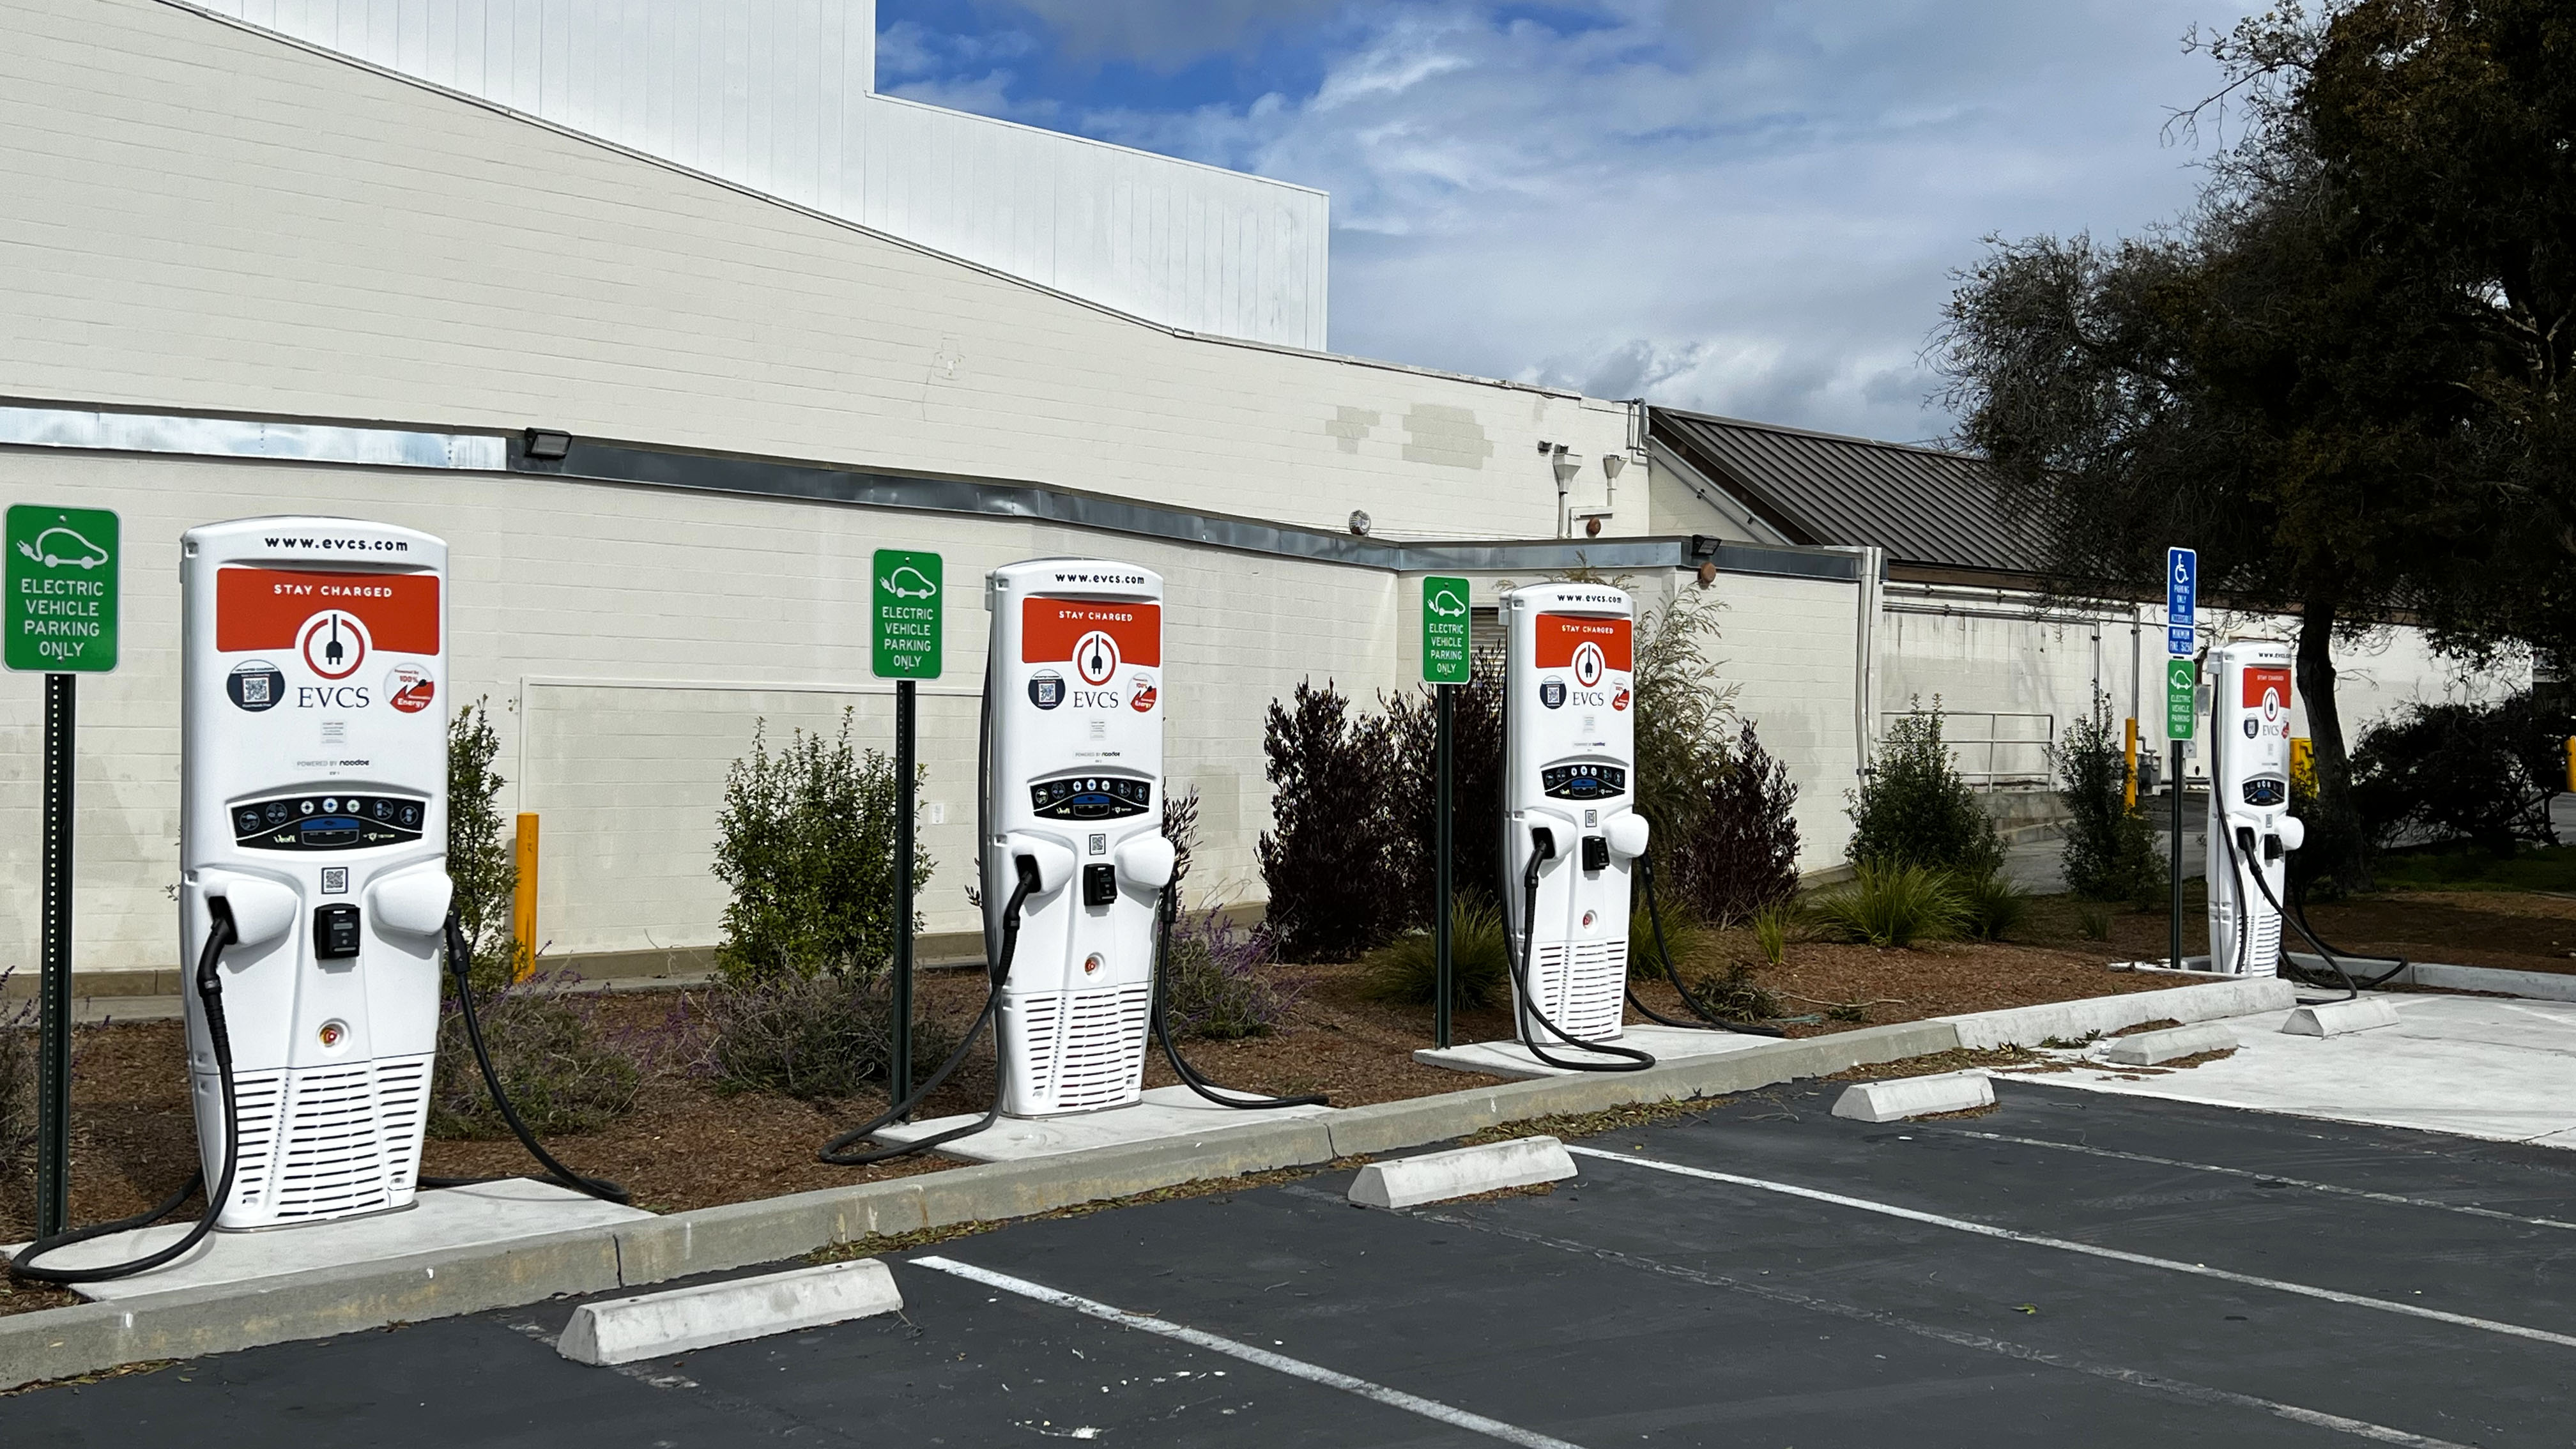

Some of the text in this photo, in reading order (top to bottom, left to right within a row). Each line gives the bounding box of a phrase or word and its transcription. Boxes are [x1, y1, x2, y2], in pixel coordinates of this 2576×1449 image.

[265, 536, 408, 551] www.evcs.com
[1055, 573, 1145, 585] www.evcs.com
[22, 579, 103, 596] ELECTRIC
[274, 585, 392, 597] STAY CHARGED
[2174, 585, 2189, 594] PARKING
[26, 599, 99, 617] VEHICLE
[882, 607, 933, 620] ELECTRIC
[1059, 611, 1133, 622] STAY CHARGED
[24, 620, 100, 636] PARKING
[885, 624, 931, 636] VEHICLE
[1429, 624, 1464, 634] ELECTRIC
[884, 640, 931, 652] PARKING
[1431, 637, 1461, 647] VEHICLE
[40, 641, 84, 657] ONLY
[1430, 650, 1462, 660] PARKING
[894, 656, 921, 668] ONLY
[1437, 663, 1455, 674] ONLY
[298, 687, 369, 709] EVCS
[397, 698, 425, 709] Energy
[1074, 691, 1118, 709] EVCS
[1573, 692, 1604, 706] EVCS
[2175, 724, 2186, 733] ONLY
[2263, 725, 2279, 735] EVCS
